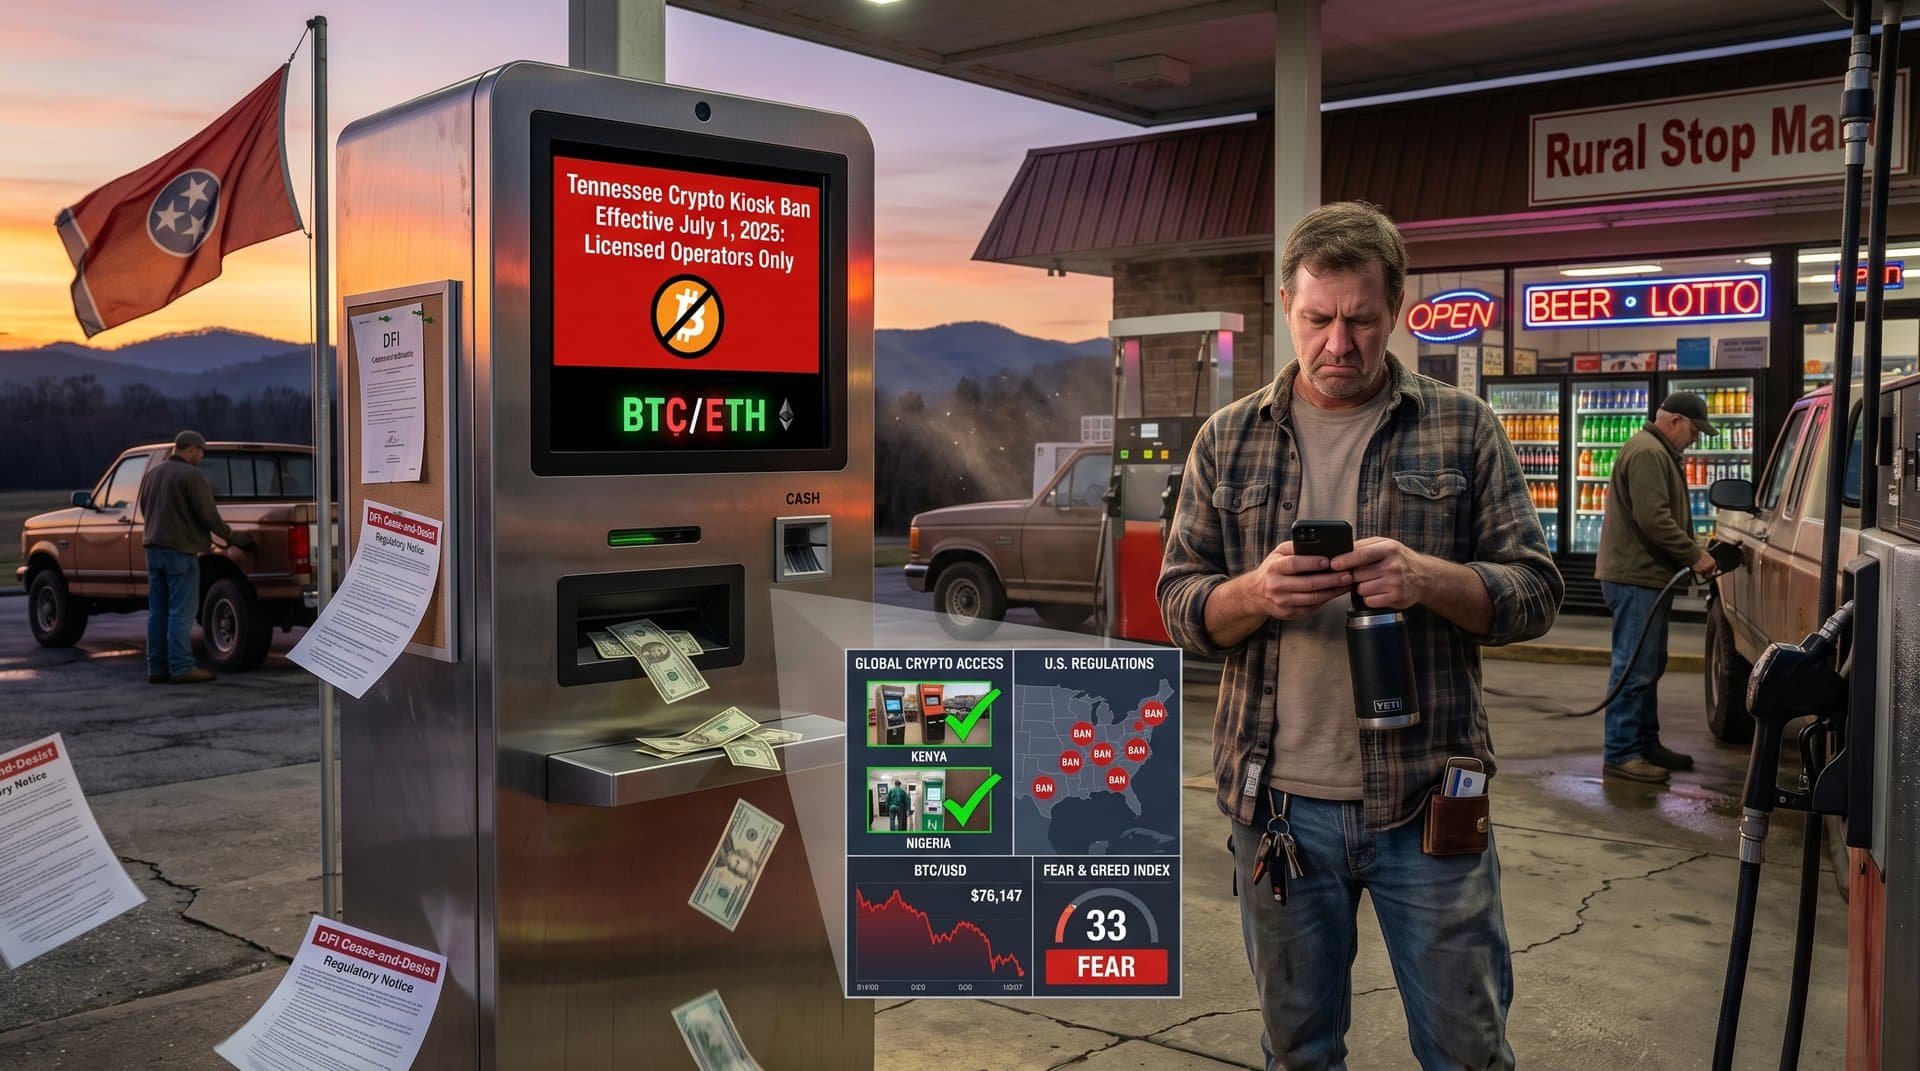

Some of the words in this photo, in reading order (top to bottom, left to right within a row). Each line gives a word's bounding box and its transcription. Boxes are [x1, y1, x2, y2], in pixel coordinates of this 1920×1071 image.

[1546, 122, 1647, 179] Rural
[1660, 117, 1756, 173] Stop
[1771, 103, 1877, 156] Ma
[566, 172, 663, 203] Tennessee
[668, 184, 725, 212] Crypto
[730, 191, 776, 216] Kiosk
[780, 196, 811, 219] Ban
[595, 205, 674, 233] Effective
[679, 213, 716, 241] July
[720, 219, 736, 242] 1,
[740, 220, 785, 243] 2025:
[584, 233, 665, 261] Licensed
[670, 241, 754, 266] Operators
[758, 249, 795, 274] Only
[1407, 301, 1495, 331] OPEN
[1530, 288, 1612, 322] BEER
[1650, 279, 1760, 317] LOTTO
[383, 330, 400, 349] DFI
[786, 492, 820, 505] CASH
[375, 531, 406, 552] Regulatory
[406, 541, 425, 556] Notice
[1376, 700, 1400, 710] YETI
[14, 772, 48, 790] Notice
[318, 931, 340, 947] DFI
[341, 938, 436, 978] Cease-and-Desist
[323, 955, 380, 985] Regulatory
[381, 974, 414, 993] Notice
